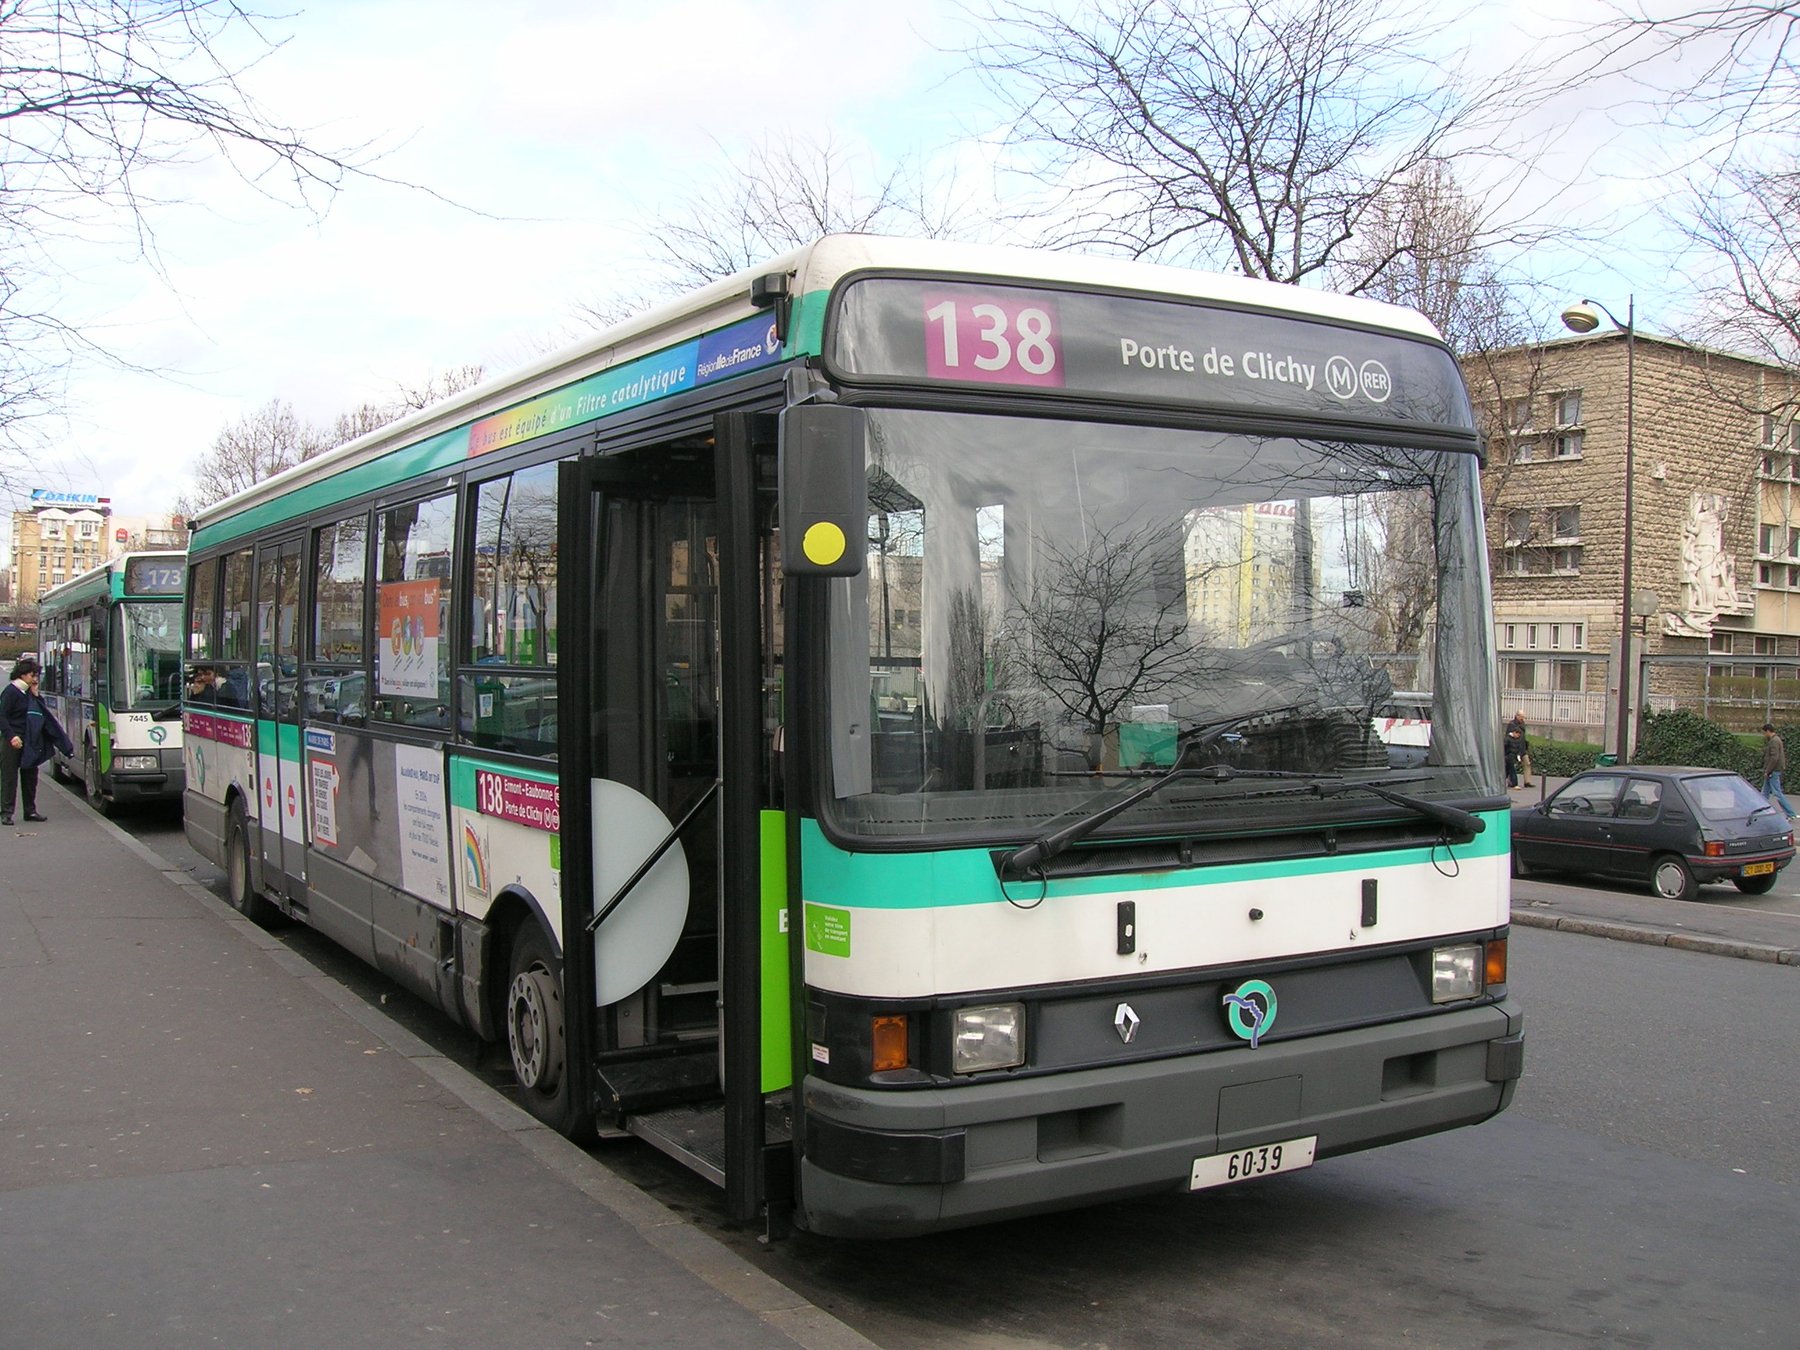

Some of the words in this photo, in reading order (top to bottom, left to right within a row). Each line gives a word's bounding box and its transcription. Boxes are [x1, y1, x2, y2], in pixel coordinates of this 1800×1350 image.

[926, 300, 1056, 375] 138
[1120, 338, 1195, 373] Porte
[1203, 347, 1234, 376] de
[1242, 351, 1316, 391] Clichy
[1363, 371, 1388, 391] RER
[483, 431, 497, 446] bus
[499, 424, 513, 441] est
[515, 408, 548, 438] équipé
[550, 403, 573, 424] d'un
[576, 393, 607, 416] Filtre
[611, 366, 686, 404] catalytique
[45, 492, 97, 504] DAIKIN
[148, 569, 181, 585] 173
[480, 773, 503, 815] 138
